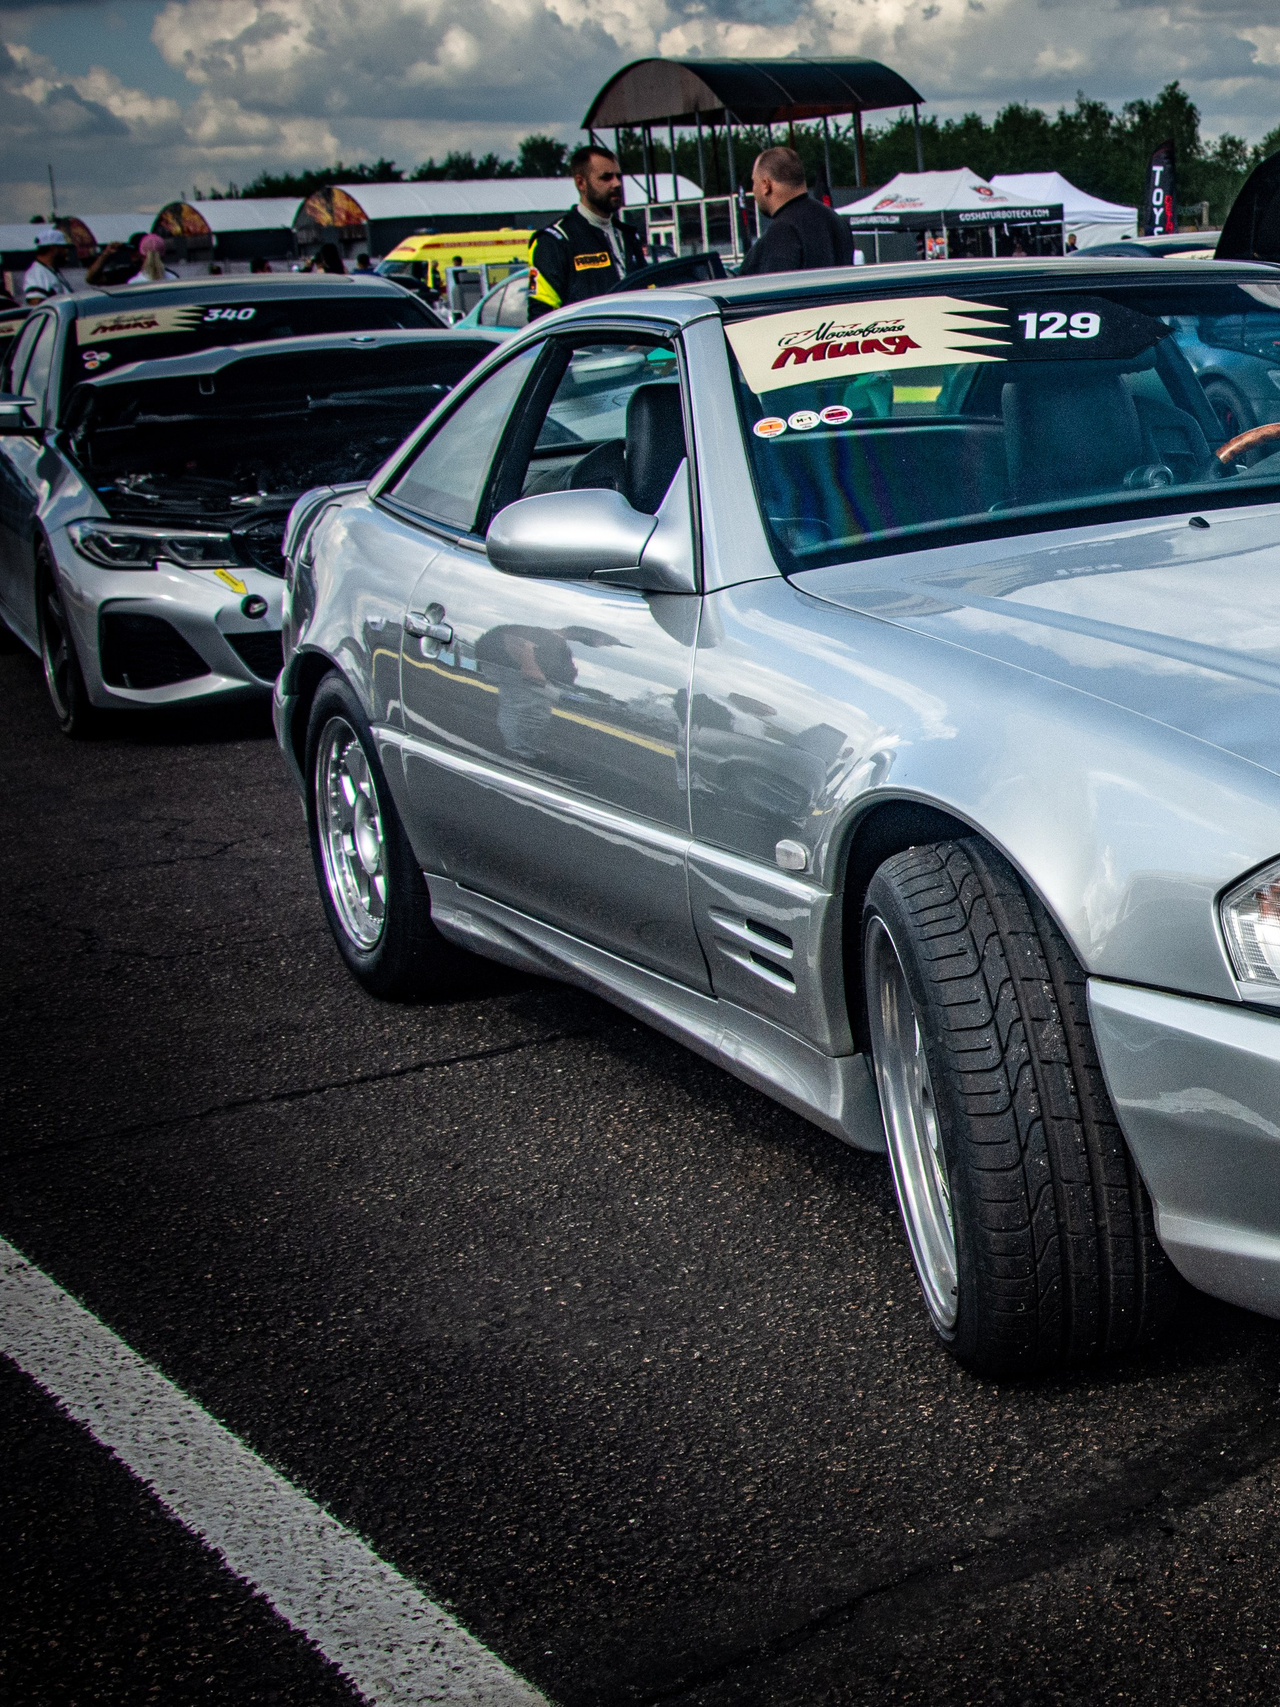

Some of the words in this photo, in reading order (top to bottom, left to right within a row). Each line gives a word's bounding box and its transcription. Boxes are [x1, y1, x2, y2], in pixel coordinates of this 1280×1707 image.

[959, 209, 1050, 222] GOSHATURBOTECH.COM
[203, 307, 257, 321] 340
[1018, 311, 1101, 340] 129
[777, 320, 906, 347] Московская
[770, 334, 923, 370] Миля
